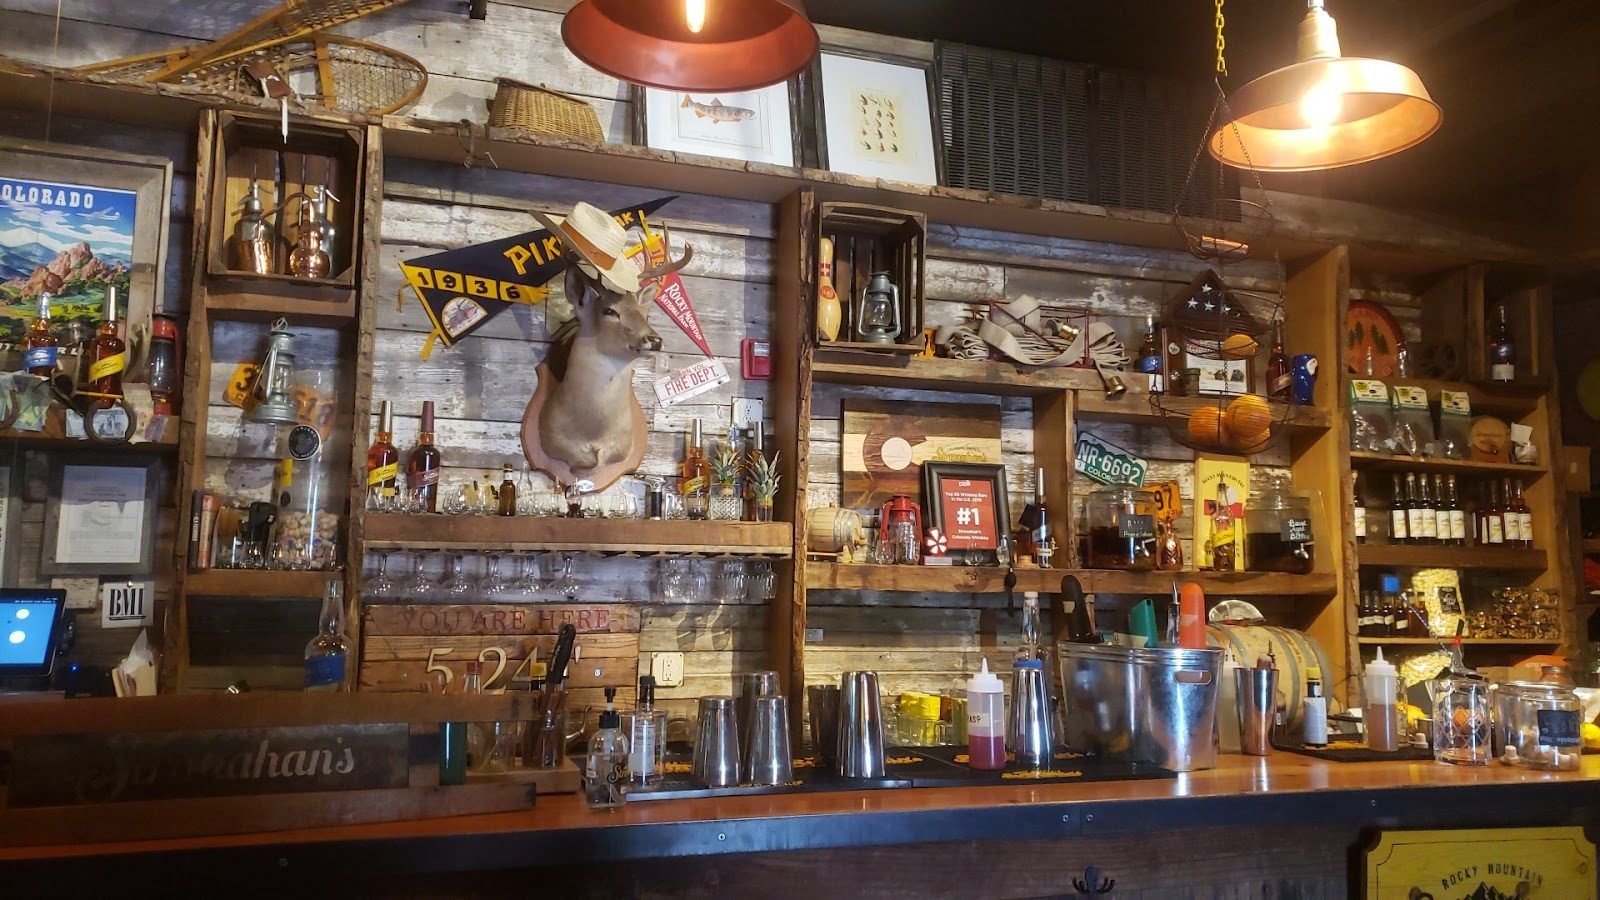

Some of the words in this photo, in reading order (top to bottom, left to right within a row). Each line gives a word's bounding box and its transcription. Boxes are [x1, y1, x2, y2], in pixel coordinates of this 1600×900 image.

[0, 183, 95, 210] OLORADO
[504, 234, 561, 275] PIK
[416, 271, 522, 301] 1936
[658, 293, 680, 318] NATIONAL
[677, 314, 690, 330] PARK
[664, 282, 689, 313] ROCKY
[682, 311, 704, 342] MOUNTAIN
[664, 377, 690, 396] FIRE
[690, 364, 720, 387] DEPT.
[956, 506, 980, 526] #1
[109, 587, 144, 616] BMI
[400, 610, 461, 631] YOU
[471, 610, 527, 631] ARE
[536, 608, 611, 632] HERE
[1441, 864, 1479, 890] ROCKY
[1487, 863, 1544, 887] MOUNTAIN
